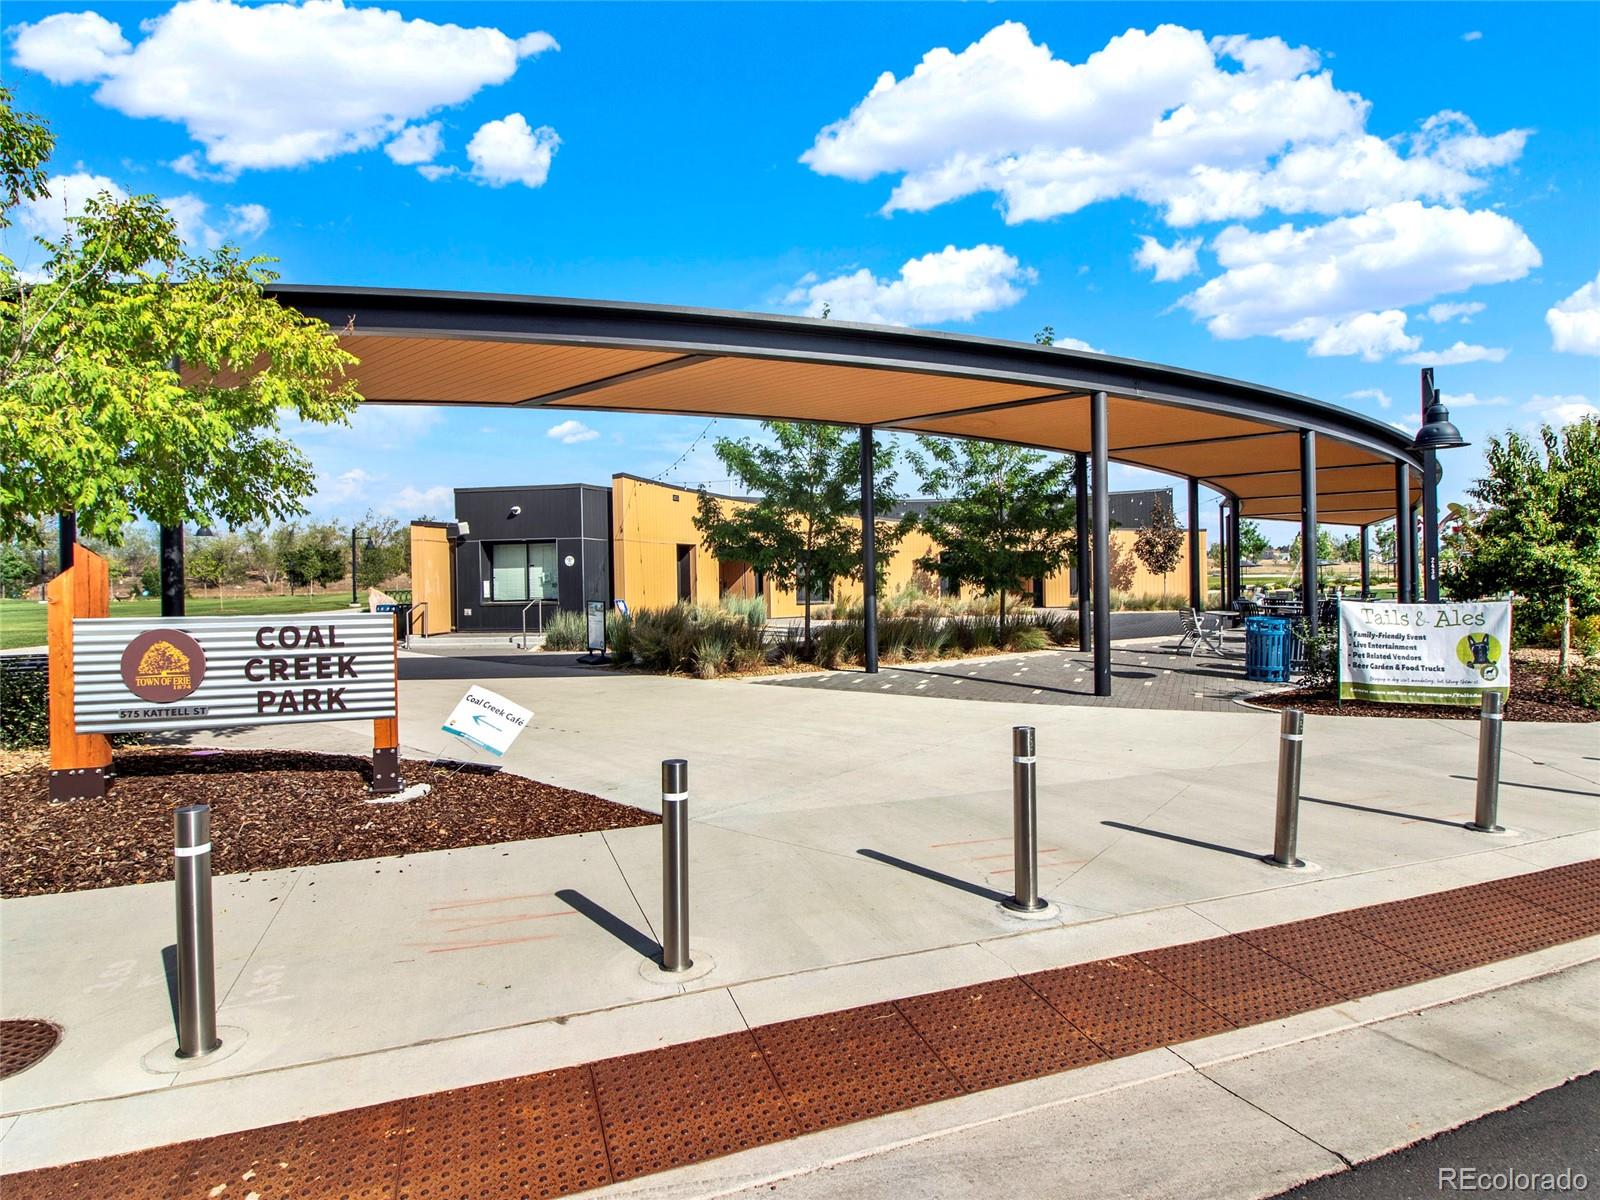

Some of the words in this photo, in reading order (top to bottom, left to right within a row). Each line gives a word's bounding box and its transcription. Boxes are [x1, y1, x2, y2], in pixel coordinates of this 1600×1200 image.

[1361, 608, 1409, 626] Tails
[1415, 610, 1430, 626] &
[1434, 609, 1485, 628] Ales
[256, 625, 345, 650] COAL
[1353, 631, 1406, 642] Family-Friendly
[1353, 641, 1367, 649] Live
[1368, 642, 1417, 651] Entertainment
[1366, 652, 1392, 660] Related
[1392, 653, 1422, 661] Vendors
[245, 655, 358, 682] CREEK
[1352, 661, 1369, 669] Beer
[1369, 662, 1394, 671] Garden
[1401, 664, 1420, 672] Food
[1420, 664, 1445, 673] Trucks
[135, 678, 160, 687] TOWN
[160, 677, 172, 686] OF
[173, 676, 191, 685] ERIE
[257, 687, 348, 714] PARK
[120, 710, 140, 719] 575
[143, 707, 190, 718] KATTELL
[193, 707, 207, 715] ST
[465, 694, 484, 706] Coal
[483, 701, 505, 716] Creek
[505, 712, 525, 727] Café
